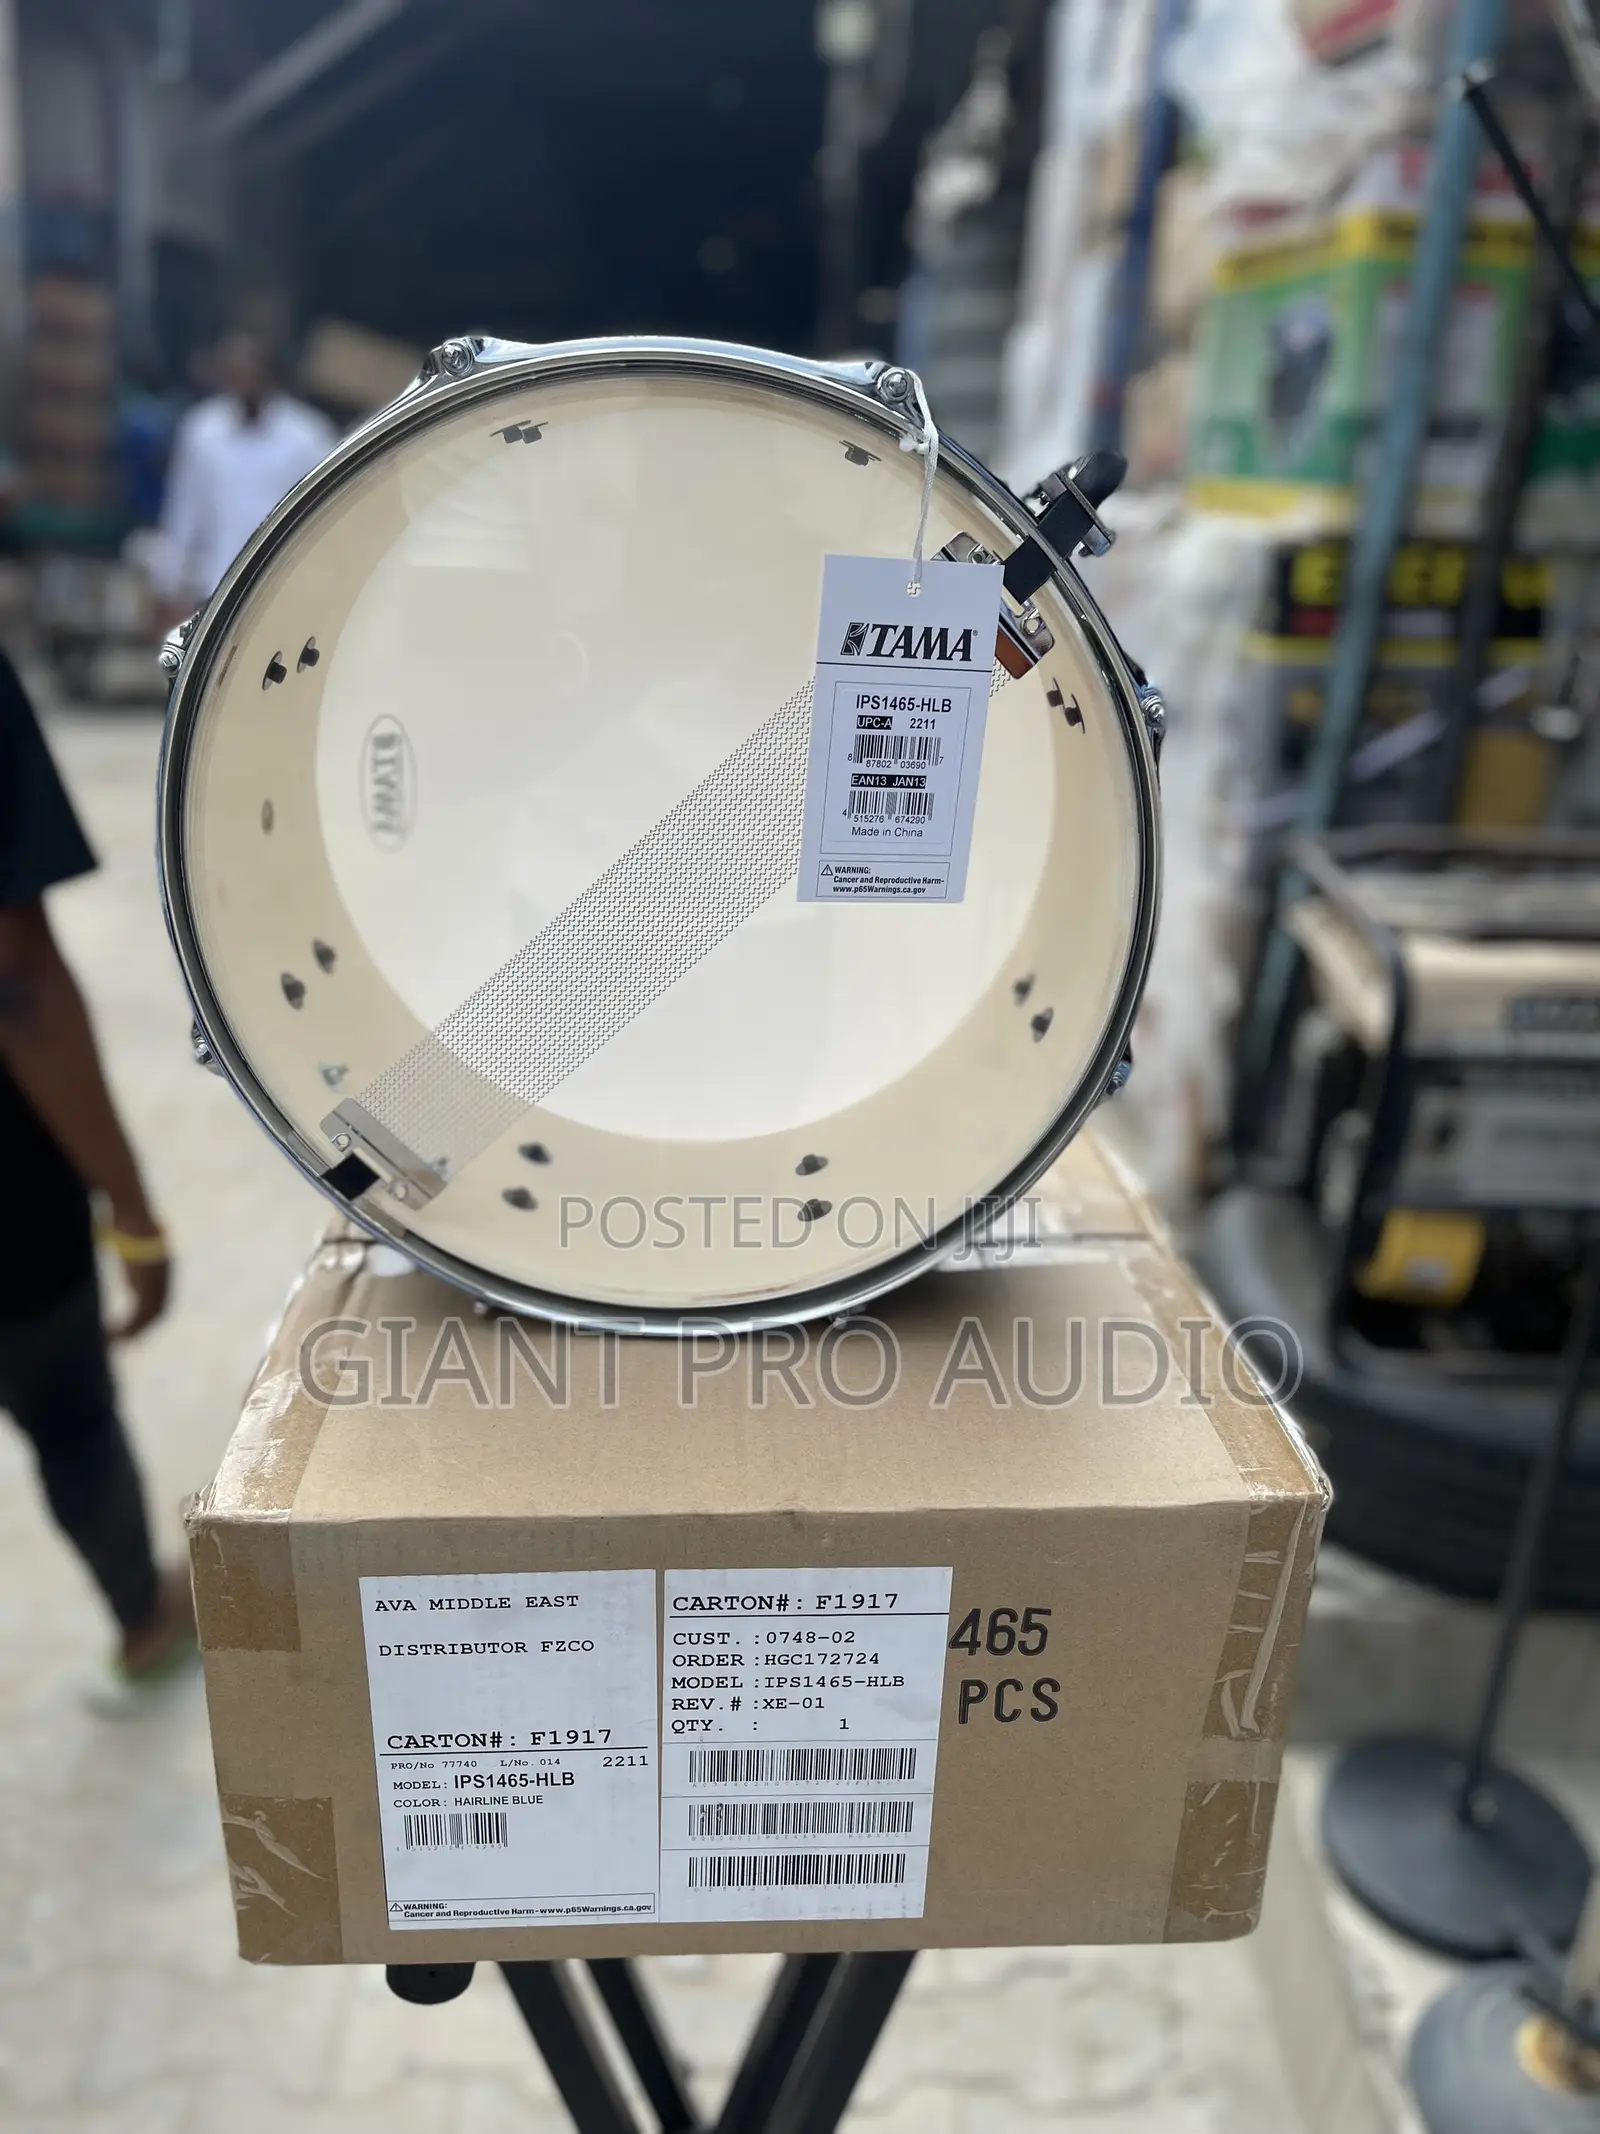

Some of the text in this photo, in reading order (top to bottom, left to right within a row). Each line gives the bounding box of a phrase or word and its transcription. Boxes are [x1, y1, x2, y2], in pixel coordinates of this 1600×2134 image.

[856, 694, 952, 713] IPS1465-HLB
[857, 716, 936, 729] UPC-A 2211
[847, 752, 853, 761] 8
[866, 760, 892, 769] 87802
[900, 760, 926, 769] 03690
[851, 775, 927, 787] EAN13 JAN13
[853, 815, 885, 823] 515276
[895, 815, 926, 824] 674290
[851, 826, 923, 838] Made in China
[834, 866, 871, 874] WARNING:
[833, 875, 859, 884] Cancer
[860, 876, 874, 884] and
[874, 877, 921, 886] Reproductive
[832, 885, 926, 895] www.p65Warnings.ca.gov
[375, 1595, 580, 1612] AVA MIDDLE EAST
[815, 1593, 899, 1610] F1917
[948, 1607, 1052, 1656] 465
[379, 1640, 595, 1656] DISTRIBUTOR FZCO
[672, 1653, 745, 1668] ORDER
[671, 1675, 744, 1690] MODEL
[958, 1677, 1061, 1724] PCS
[839, 1718, 849, 1730] 1
[530, 1729, 611, 1745] F1917
[391, 1762, 435, 1770] PRO/No
[540, 1758, 560, 1766] 014
[603, 1755, 649, 1767] 2211
[454, 1772, 575, 1789] IPS1465-HLB
[454, 1797, 509, 1806] HAIRLINE
[512, 1795, 543, 1805] BLUE
[403, 1903, 447, 1911] WARNING:
[453, 1907, 510, 1917] Reproductive
